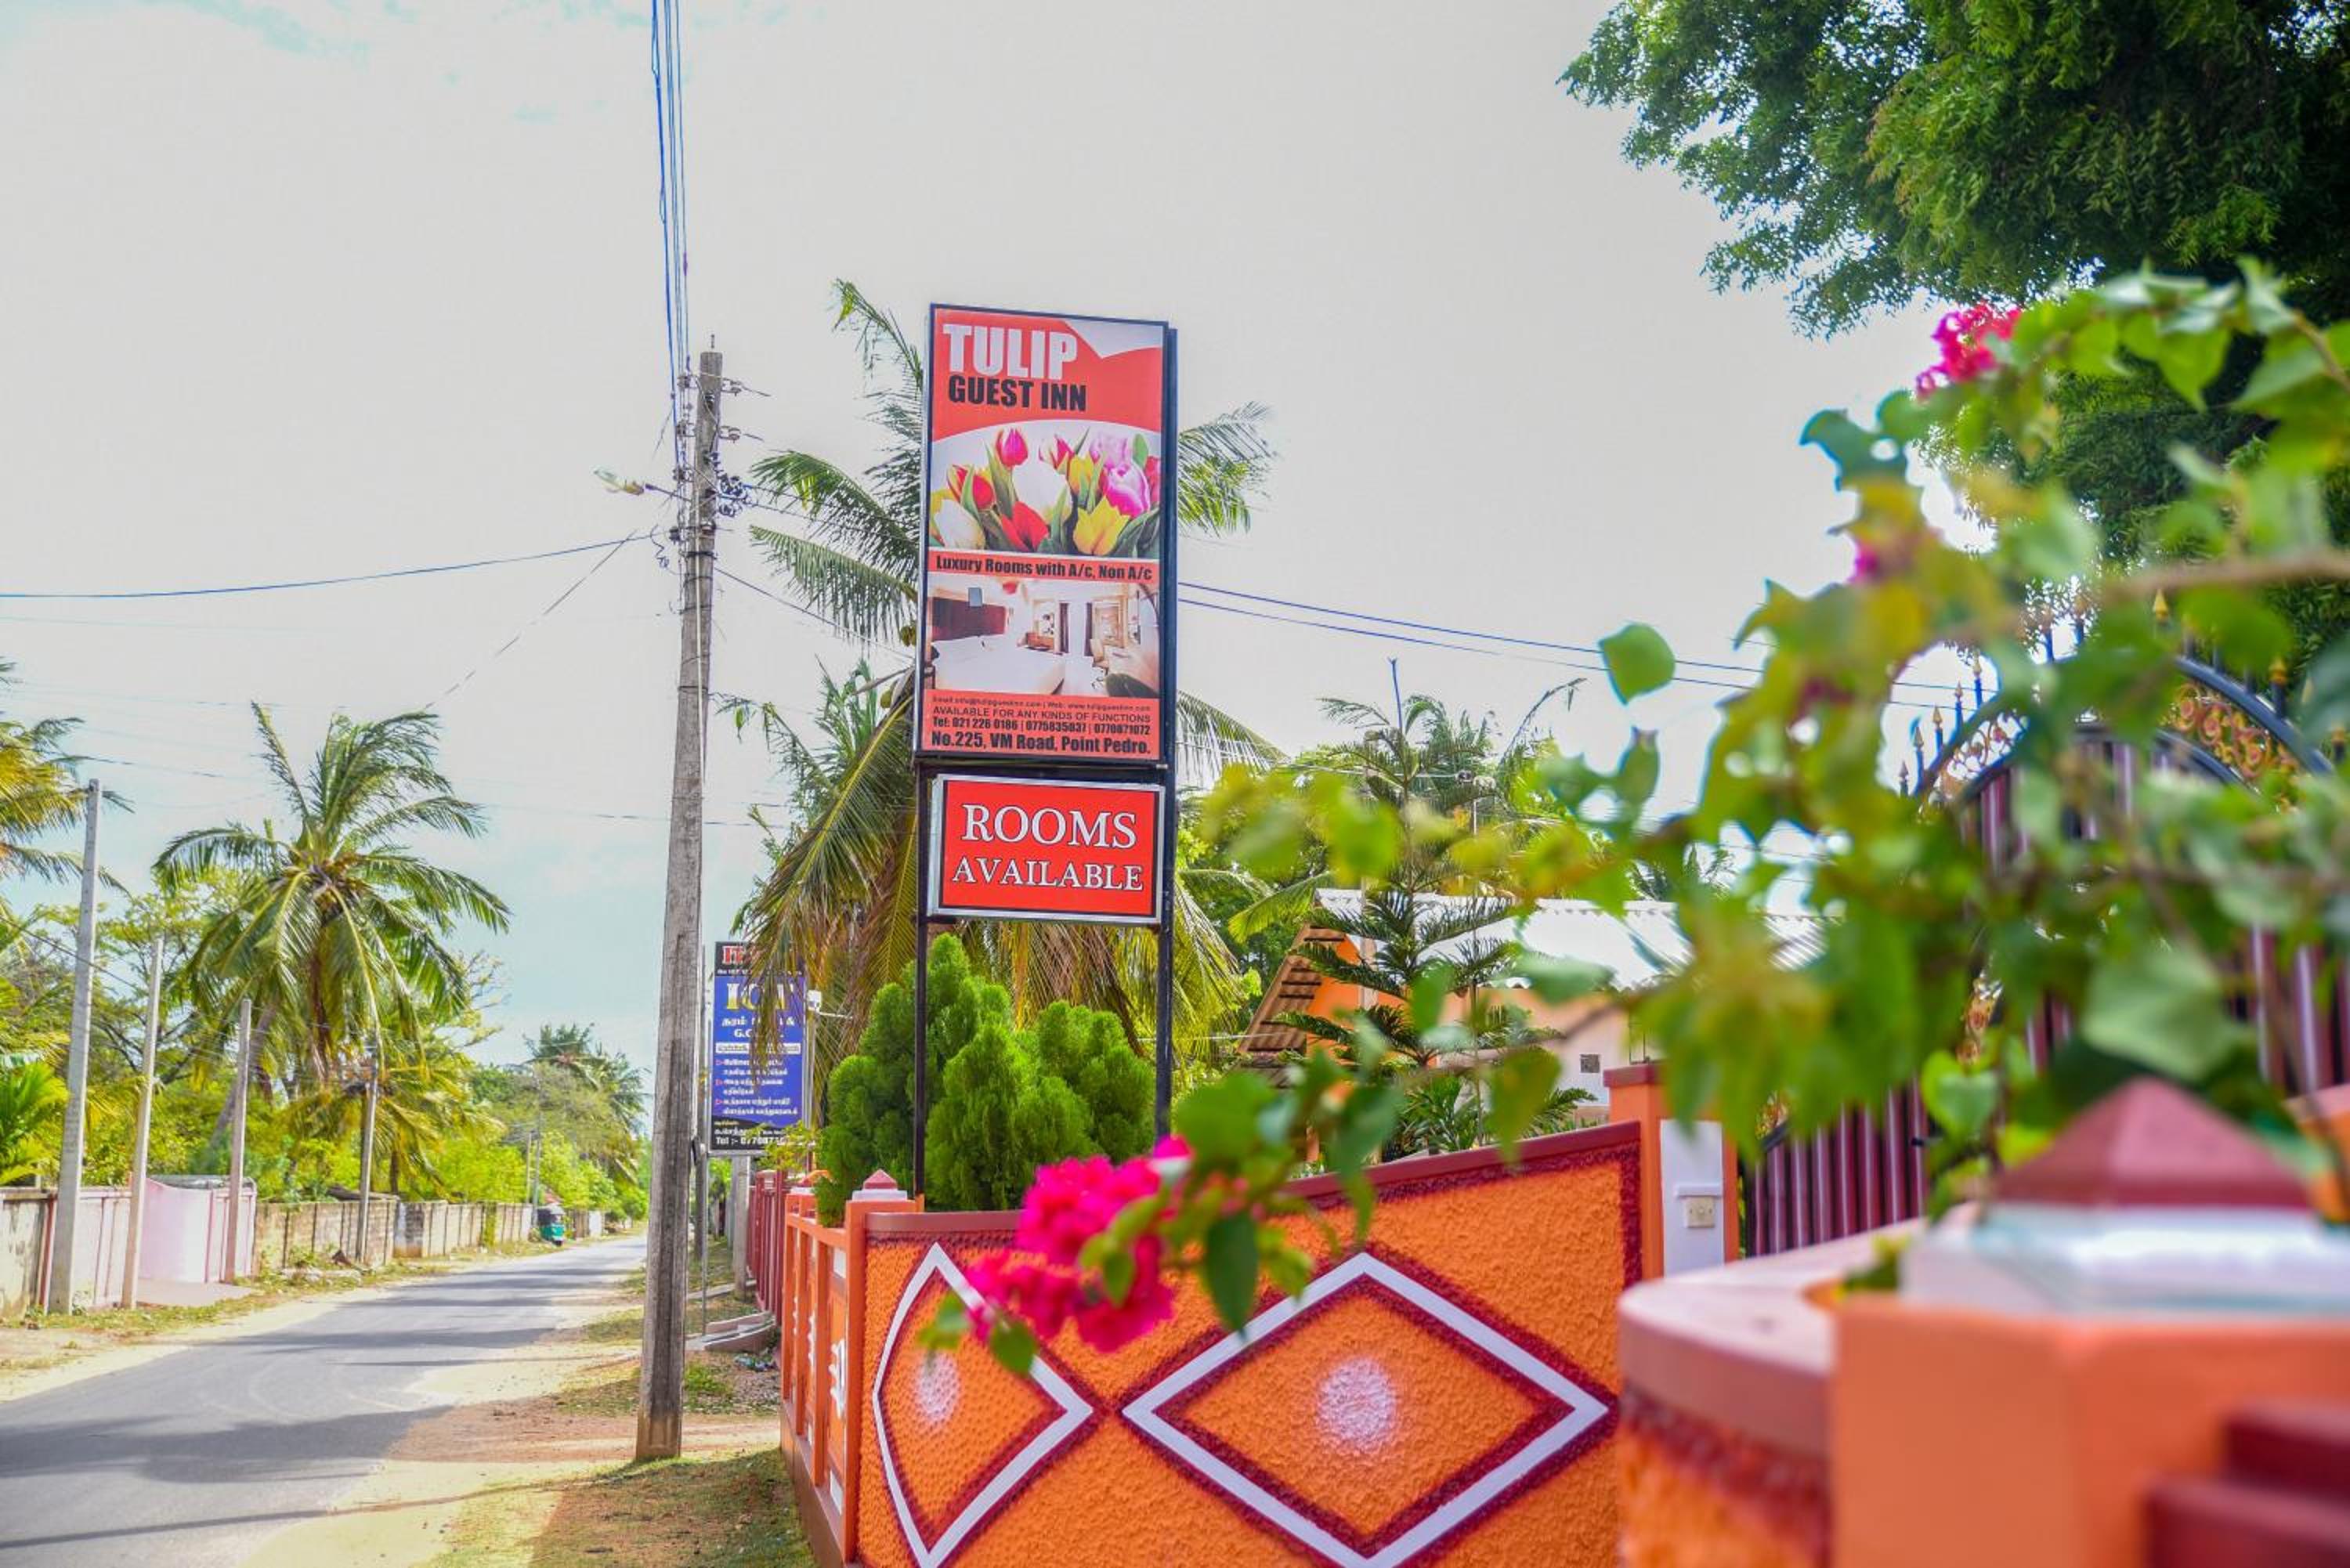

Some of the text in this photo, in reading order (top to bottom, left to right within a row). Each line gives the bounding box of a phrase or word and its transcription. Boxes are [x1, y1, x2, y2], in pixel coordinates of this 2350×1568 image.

[943, 323, 1078, 380] TULIP
[949, 374, 1086, 411] GUEST INN
[936, 555, 982, 573] Luxury
[985, 558, 1032, 574] Rooms
[1036, 562, 1065, 576] with
[1099, 565, 1124, 579] Non
[1128, 566, 1152, 580] A/c
[933, 706, 989, 716] AVAILABLE
[992, 709, 1014, 717] FOR
[1018, 710, 1038, 718] ANY
[1041, 711, 1072, 720] KINDS
[1092, 713, 1151, 722] FUNCTIONS
[931, 731, 1151, 754] No.225, VM Road, Point Pedro.
[961, 804, 1137, 849] ROOMS
[952, 856, 1144, 891] AVAILABLE
